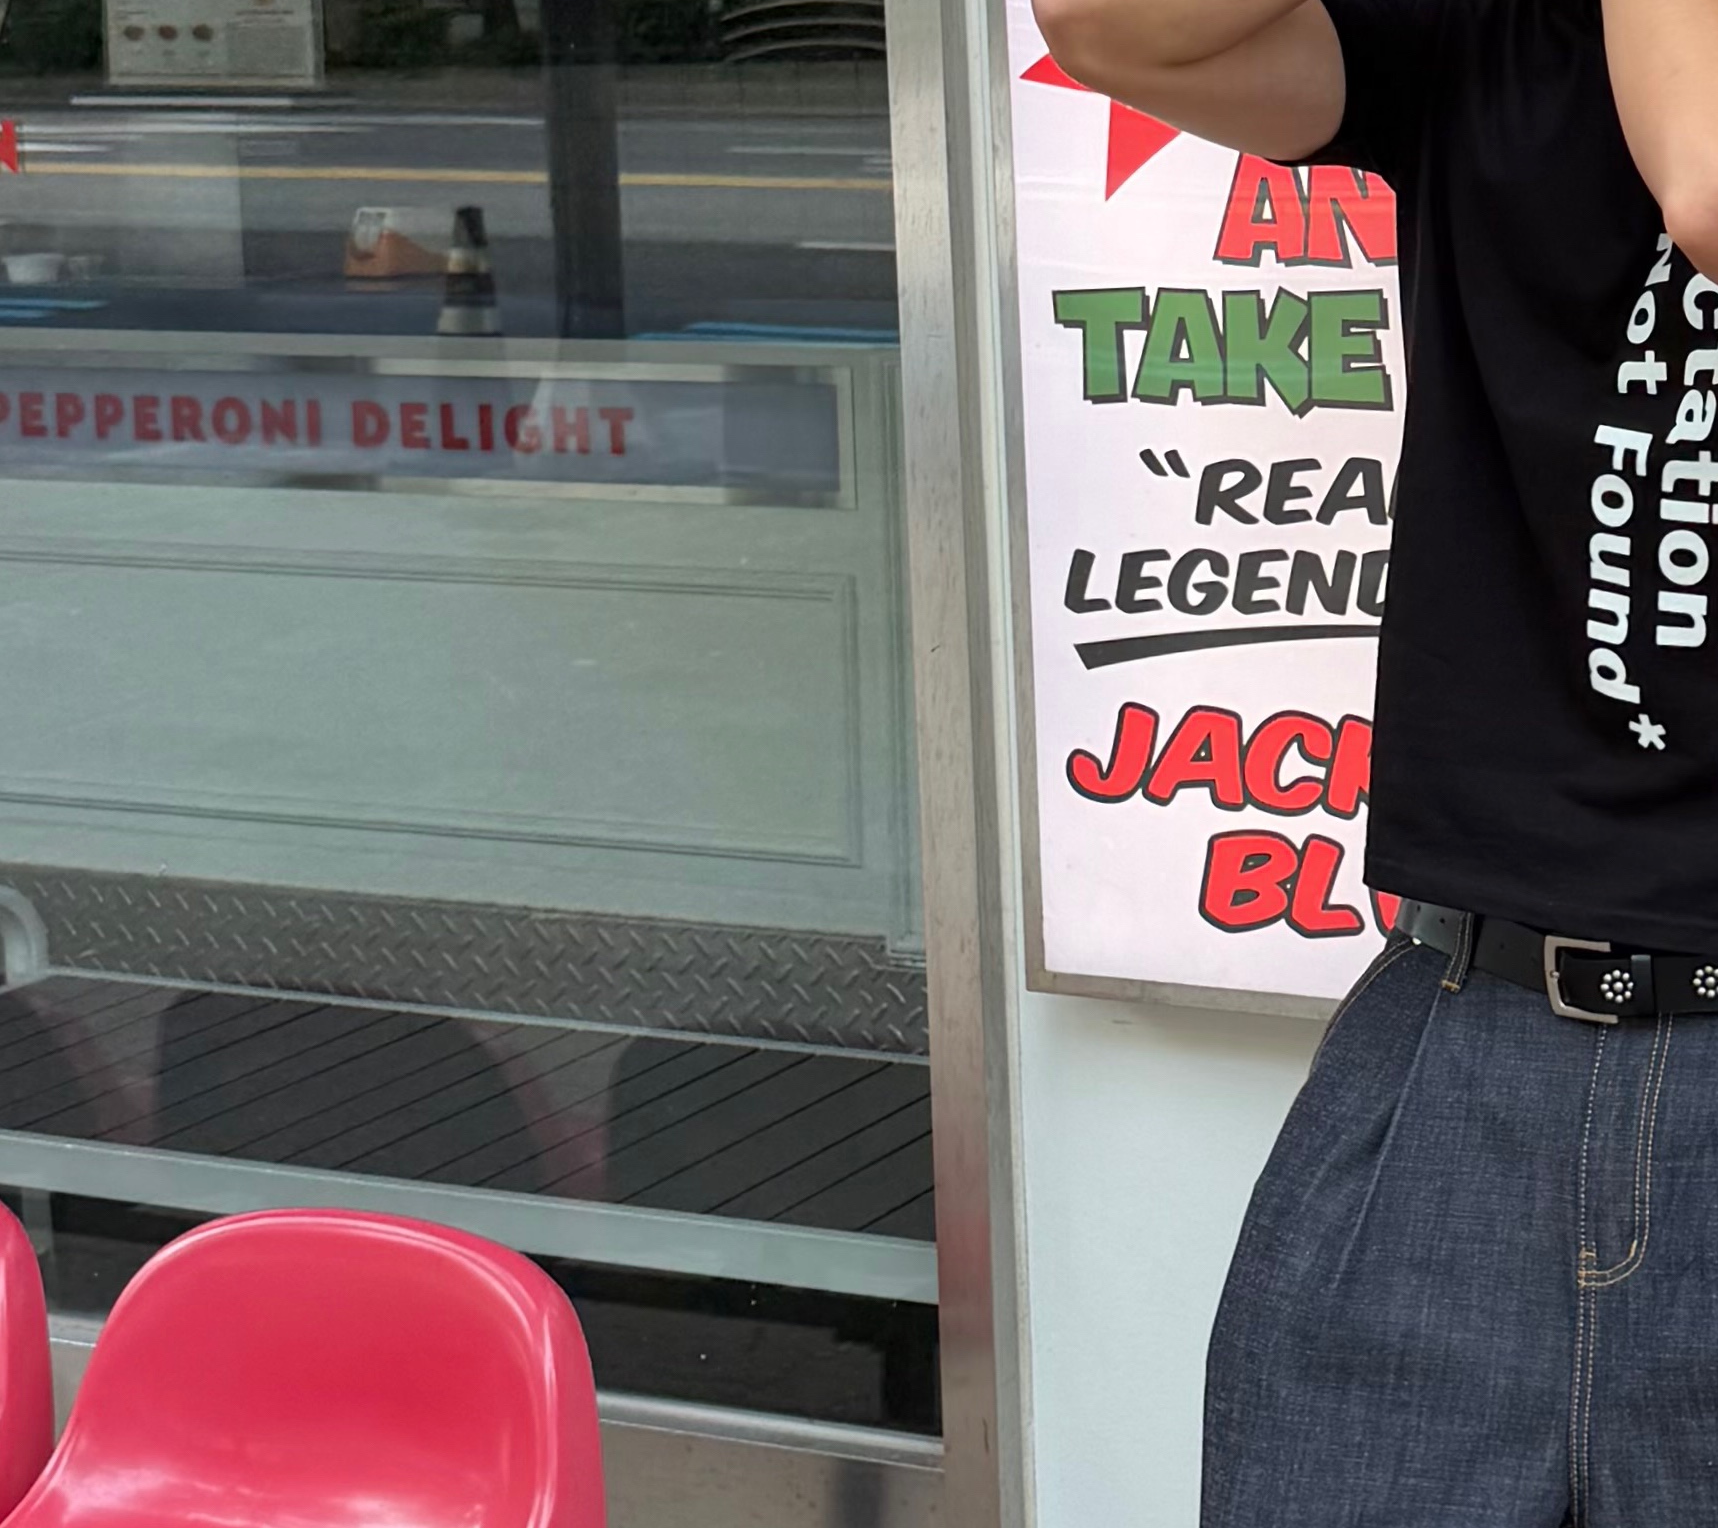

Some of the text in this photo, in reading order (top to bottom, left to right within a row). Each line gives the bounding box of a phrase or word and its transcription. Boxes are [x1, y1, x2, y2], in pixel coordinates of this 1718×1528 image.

[1053, 286, 1394, 418] TAKE
[350, 398, 635, 456] DELIGHT
[1139, 448, 1397, 526] “REA
